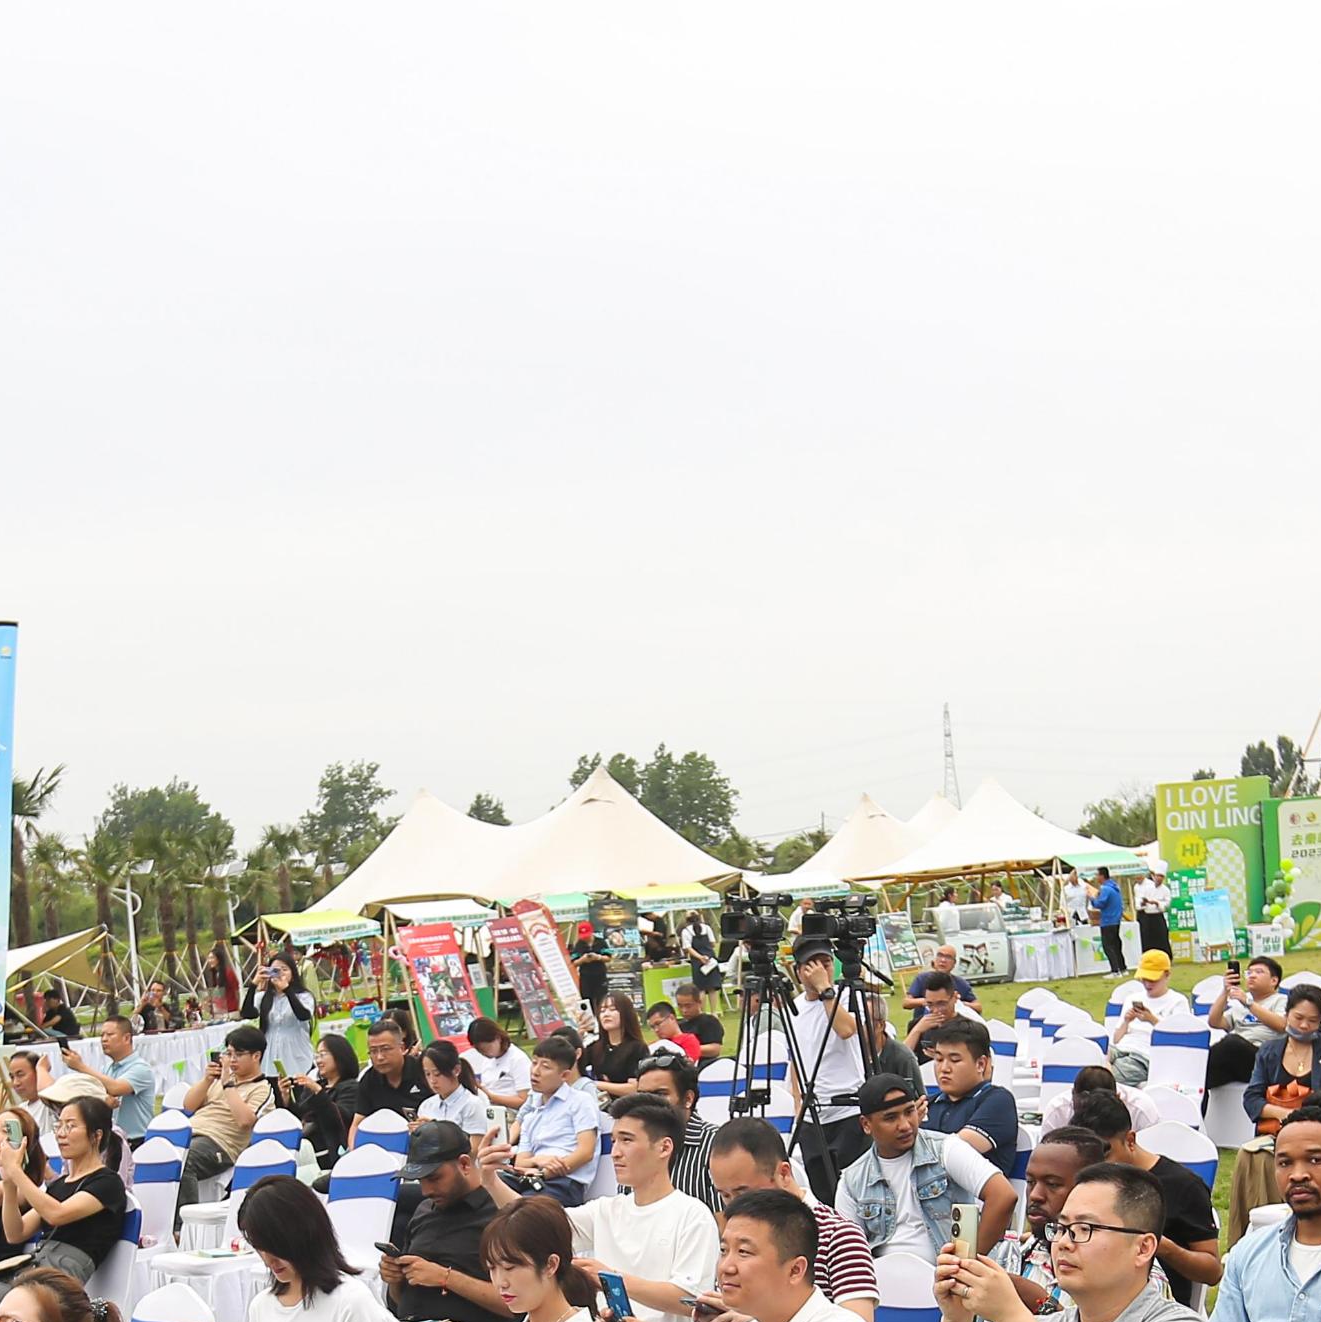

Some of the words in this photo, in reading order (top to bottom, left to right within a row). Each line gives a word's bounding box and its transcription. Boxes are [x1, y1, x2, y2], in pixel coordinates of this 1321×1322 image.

[1165, 788, 1173, 808] I
[1179, 784, 1238, 807] LOVE
[1166, 810, 1207, 831] QIN
[1181, 843, 1200, 857] HI
